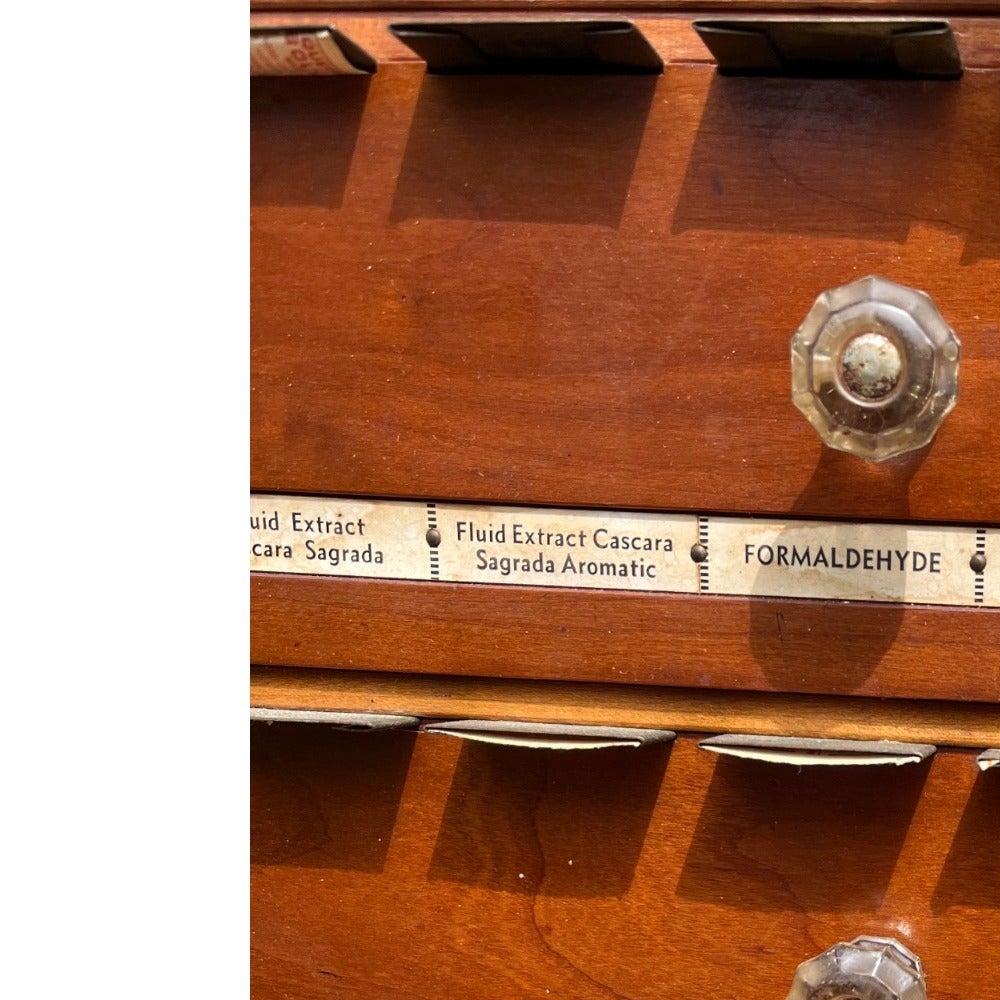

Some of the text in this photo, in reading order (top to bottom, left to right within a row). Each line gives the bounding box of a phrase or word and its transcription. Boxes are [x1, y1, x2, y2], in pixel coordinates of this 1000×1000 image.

[291, 512, 366, 537] Extract
[456, 520, 675, 553] Fluid Extract Cascara
[304, 539, 385, 567] Sagrada
[475, 548, 658, 580] Sagrada Aromatic
[744, 543, 943, 575] FORMALDEHYDE
